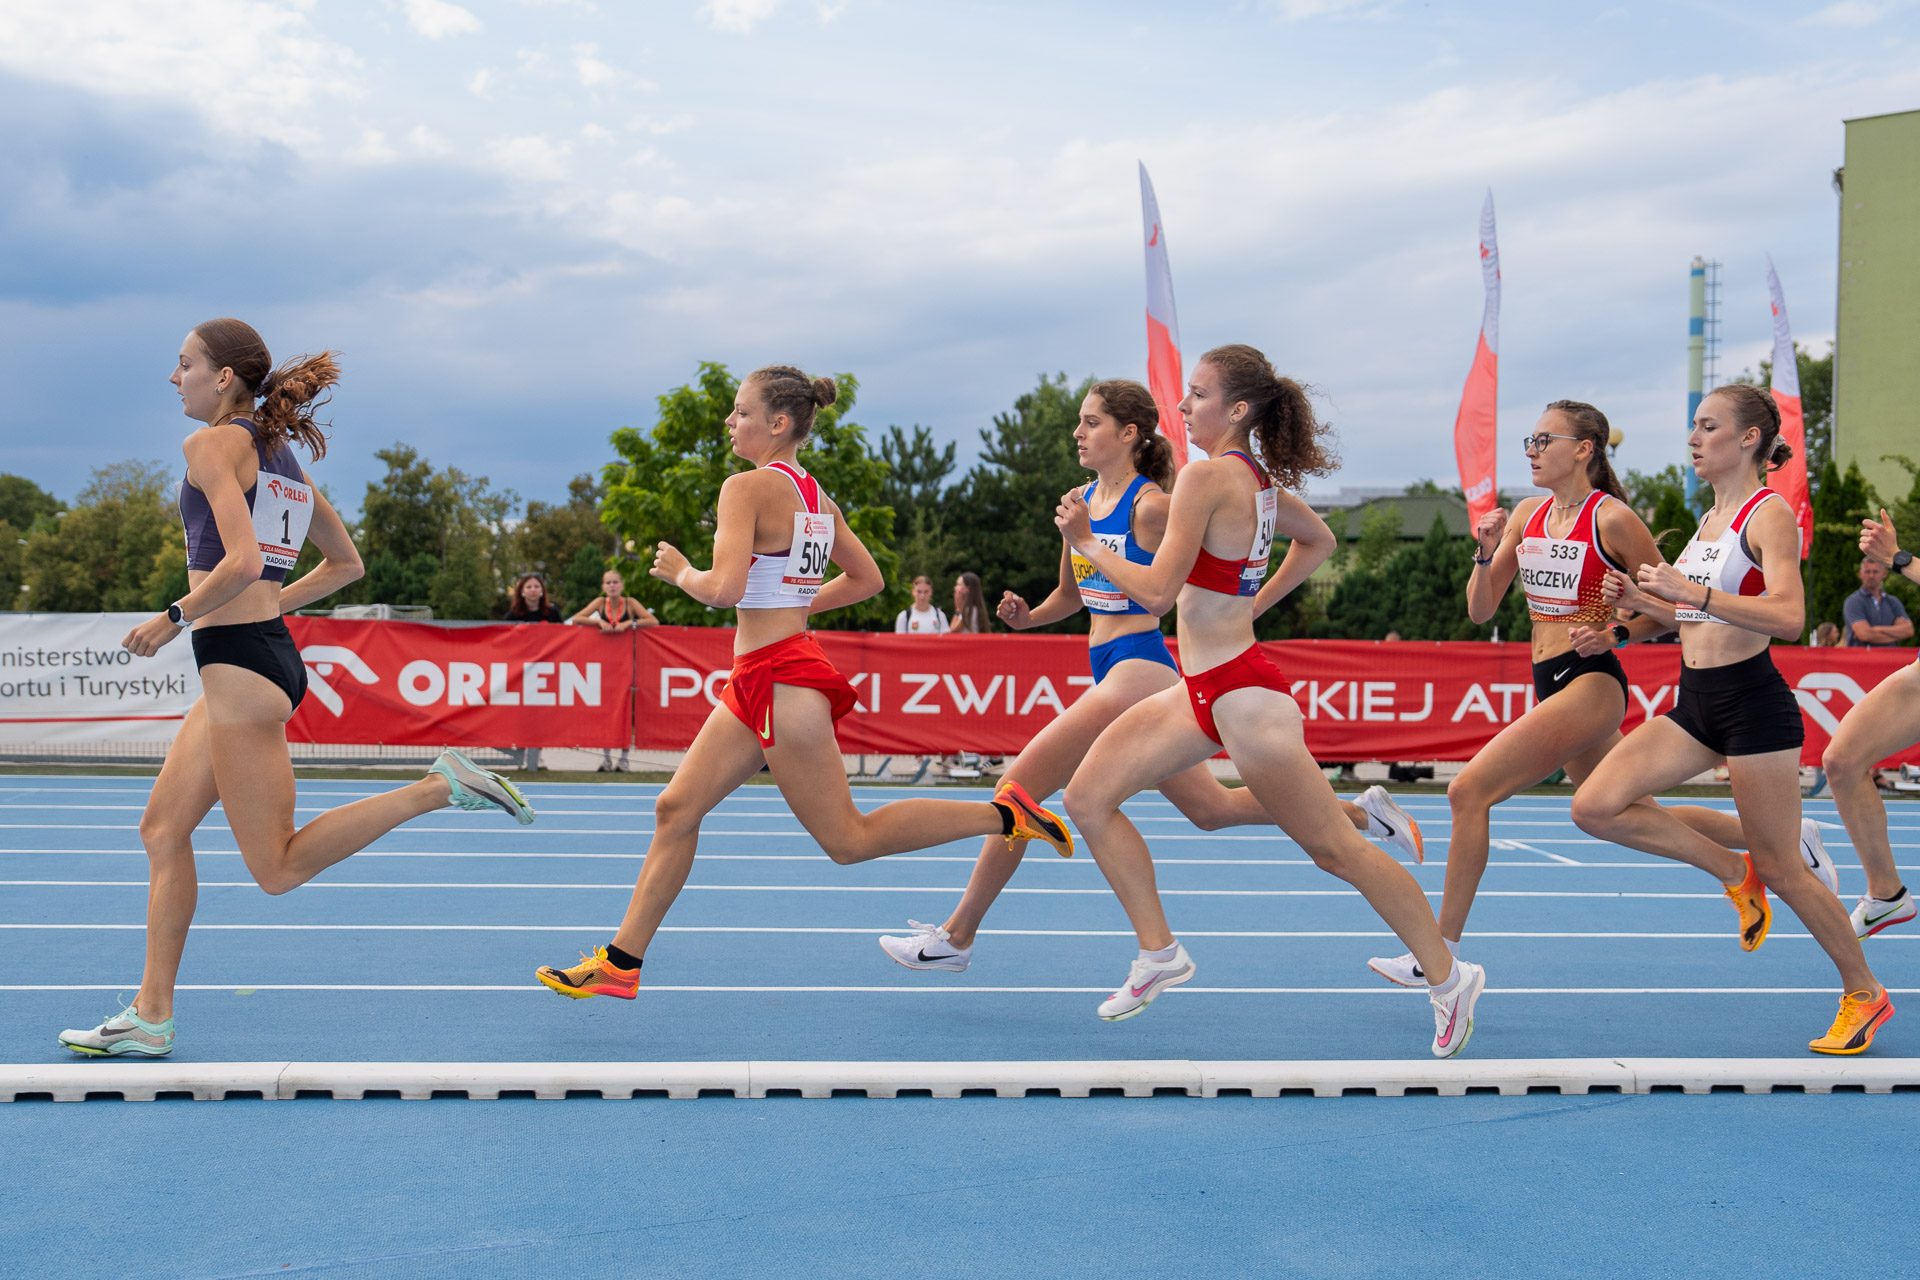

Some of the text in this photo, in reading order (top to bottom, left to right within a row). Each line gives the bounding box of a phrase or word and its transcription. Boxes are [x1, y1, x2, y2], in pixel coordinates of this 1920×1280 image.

[283, 486, 308, 504] ORLEN
[281, 509, 291, 545] 1
[799, 541, 828, 575] 506
[1550, 544, 1579, 560] 533
[1702, 547, 1720, 562] 34
[266, 556, 287, 567] RADOM
[1545, 604, 1560, 613] 2024
[1695, 612, 1710, 620] 2024
[2, 646, 131, 667] nisterstwo
[0, 674, 185, 699] ortu i Turystyki
[398, 660, 602, 707] ORLEN
